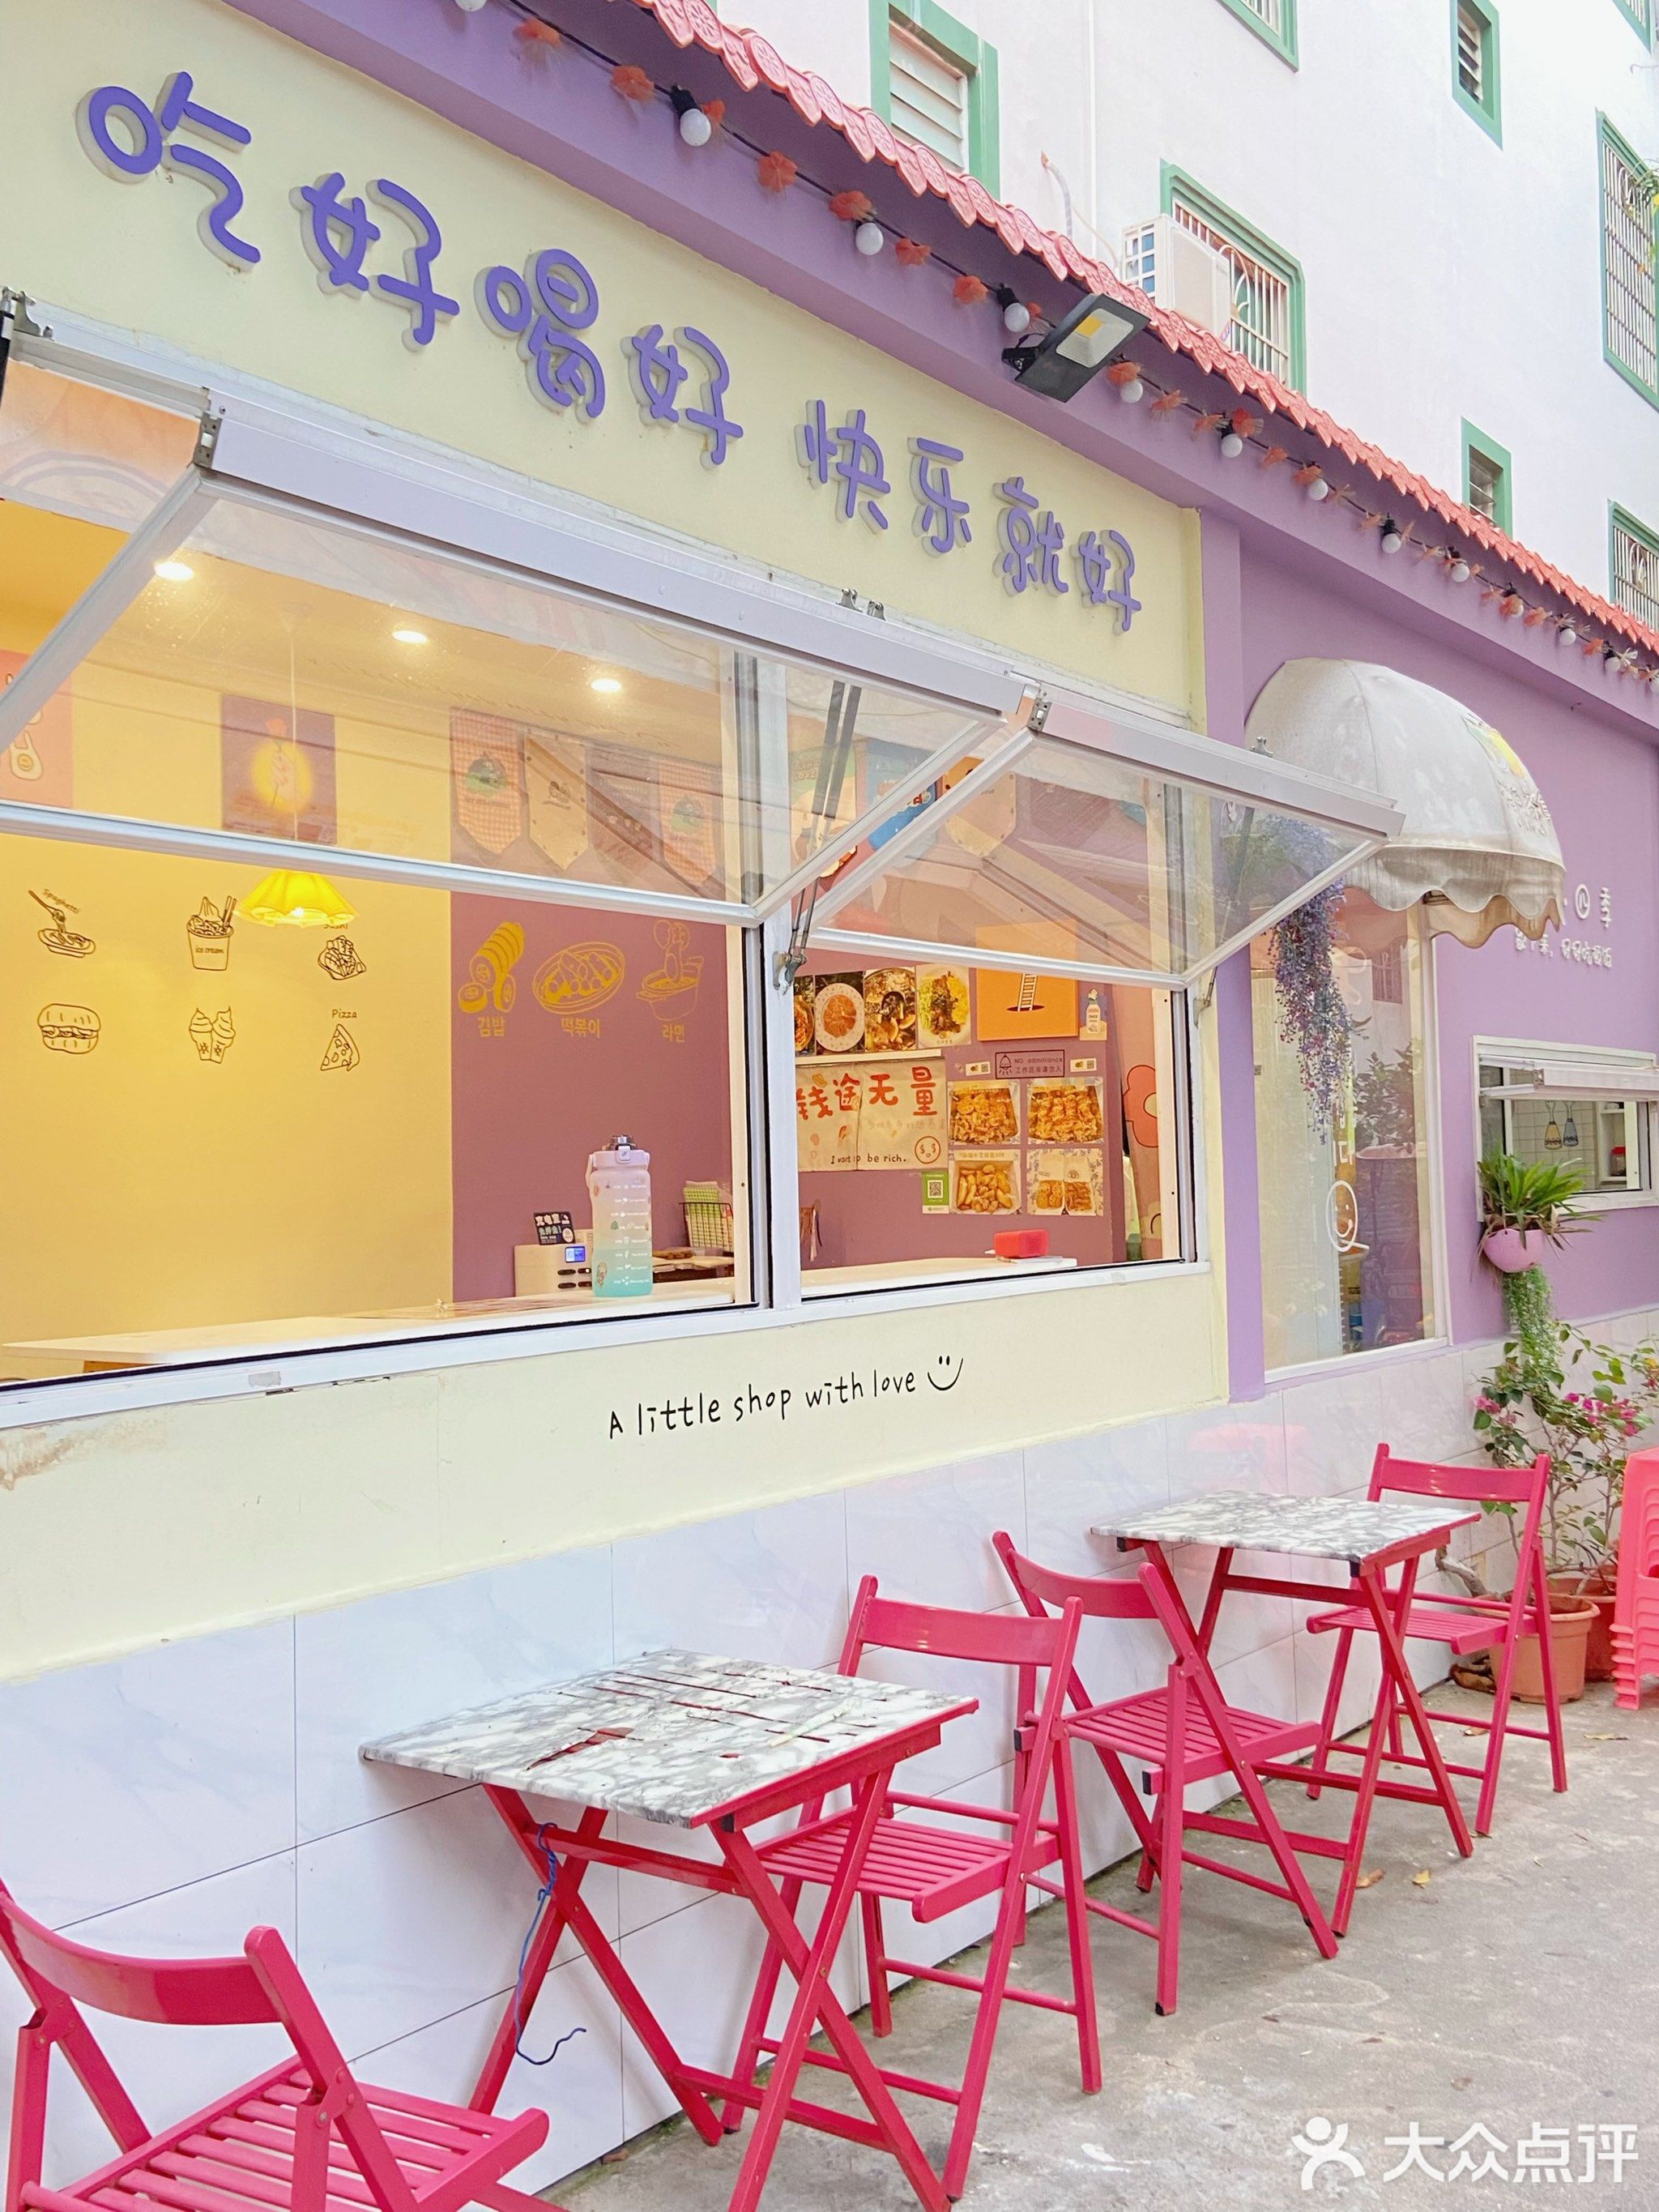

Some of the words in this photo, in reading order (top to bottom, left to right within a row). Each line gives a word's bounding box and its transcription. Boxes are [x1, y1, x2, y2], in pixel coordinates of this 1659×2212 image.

[83, 71, 744, 466] 吃好喝好
[800, 399, 1141, 632] 快乐就好
[331, 1009, 357, 1018] Pizza
[477, 1016, 506, 1037] 김밥
[561, 1017, 601, 1038] 떡볶이
[662, 1024, 686, 1044] 라면
[795, 1065, 938, 1121] 钱途无量
[867, 1152, 880, 1163] be
[884, 1153, 906, 1163] rich.
[609, 1411, 624, 1440] A
[638, 1392, 722, 1435] little
[734, 1384, 791, 1420] shop
[805, 1371, 864, 1408] with
[873, 1369, 917, 1398] love
